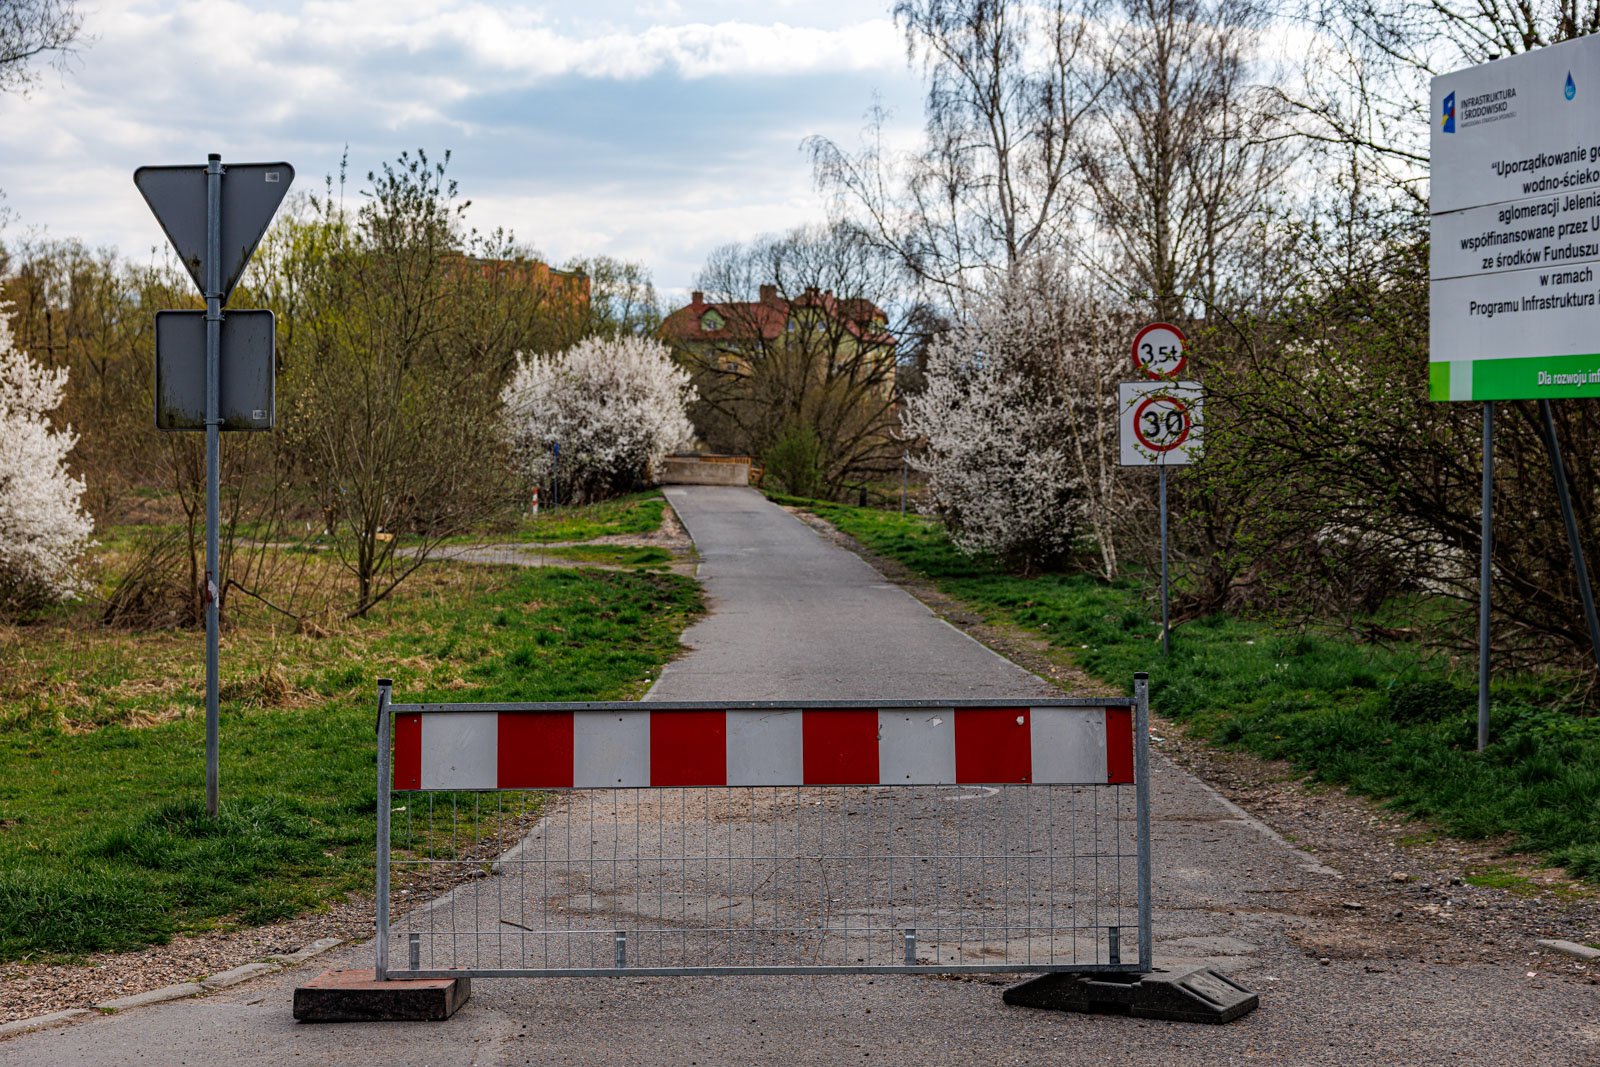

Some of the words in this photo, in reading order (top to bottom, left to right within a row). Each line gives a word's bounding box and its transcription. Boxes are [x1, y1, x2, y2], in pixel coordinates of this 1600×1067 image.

[1461, 88, 1516, 109] INFRASTRUKTURA
[1499, 198, 1560, 225] aglomeracji
[1461, 226, 1555, 251] współfinansowane
[1558, 221, 1588, 240] przez
[1591, 215, 1600, 231] U
[1482, 256, 1493, 269] ze
[1497, 249, 1541, 268] środków
[1544, 243, 1599, 261] Funduszu
[1540, 274, 1549, 286] w
[1552, 267, 1593, 286] ramach
[1470, 300, 1519, 318] Programu
[1522, 293, 1595, 312] Infrastruktura
[1538, 371, 1551, 385] Dla
[1553, 369, 1587, 387] rozwoju
[1143, 410, 1183, 438] 30
